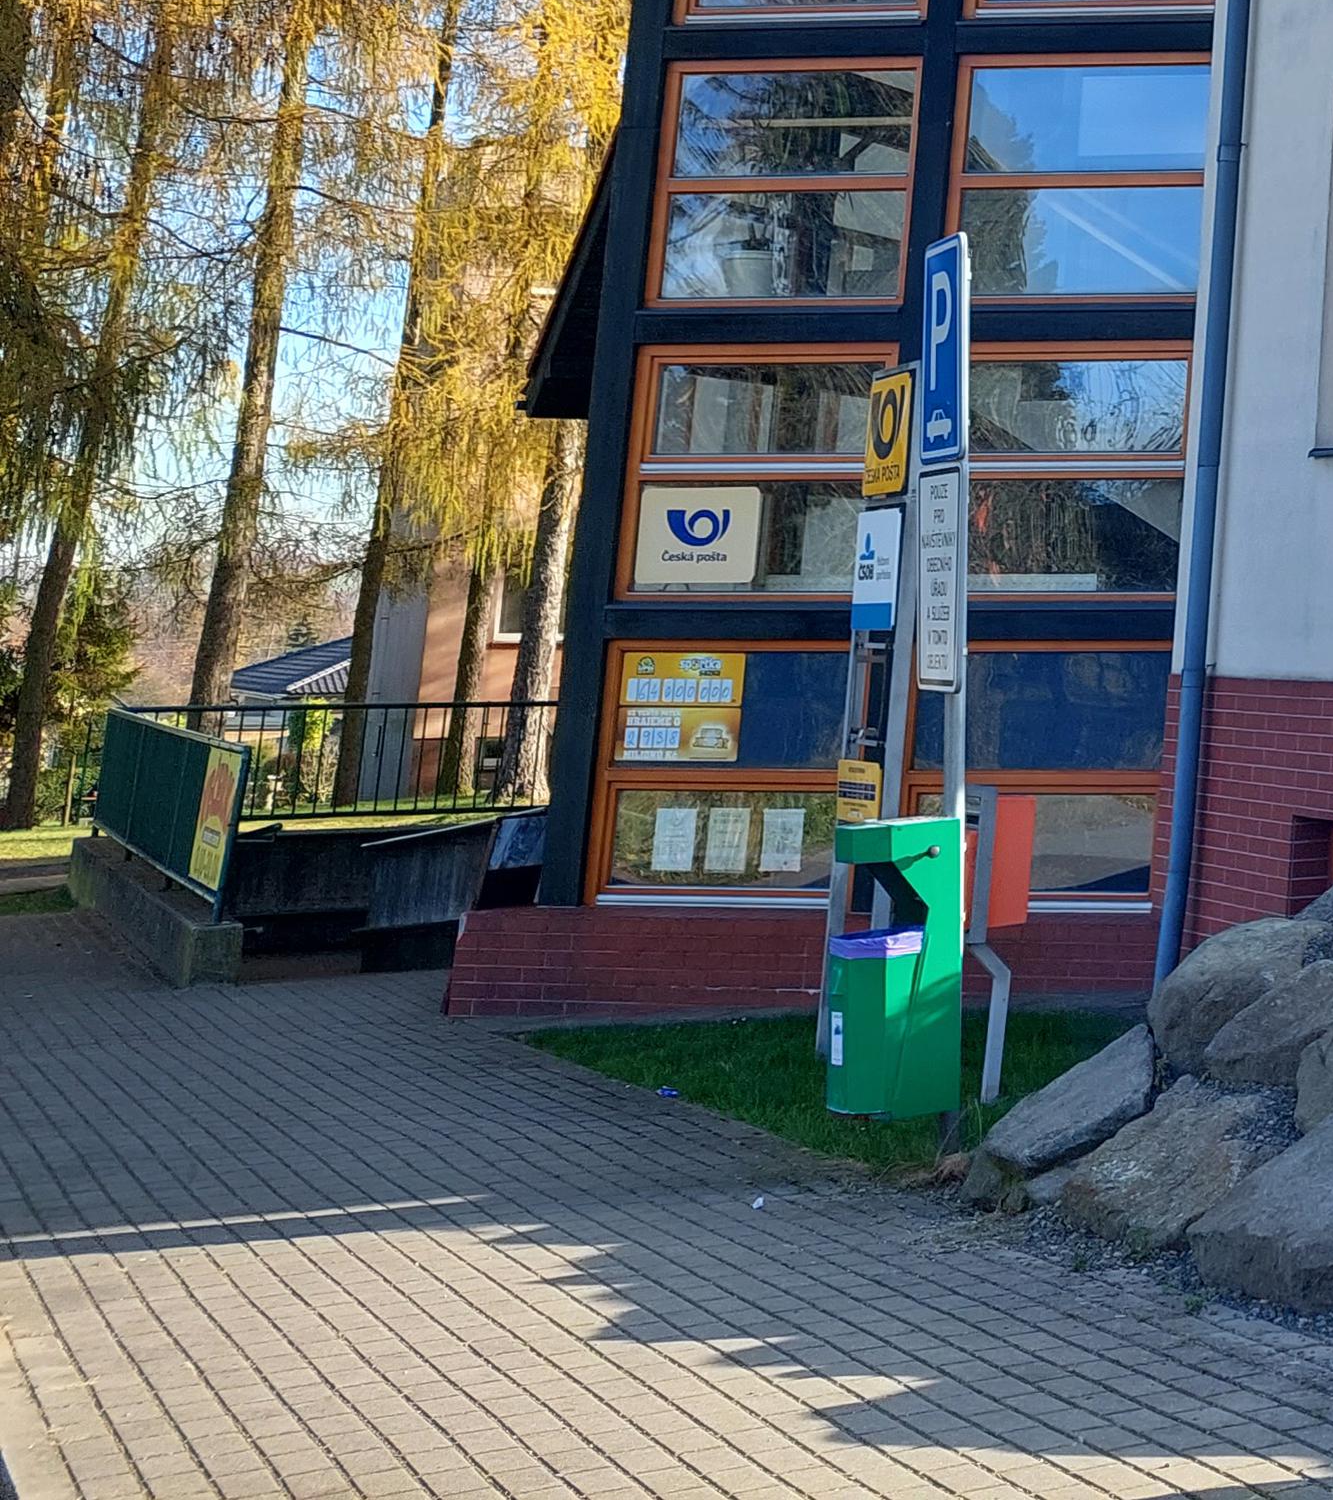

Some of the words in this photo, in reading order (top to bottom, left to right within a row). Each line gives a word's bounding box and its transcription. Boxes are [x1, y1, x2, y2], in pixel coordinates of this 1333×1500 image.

[930, 270, 952, 391] P
[865, 465, 881, 485] ČESKÁ
[881, 461, 900, 483] POŠTA
[930, 483, 948, 500] POUZE
[933, 508, 945, 524] PRO
[661, 549, 694, 563] Česká
[696, 550, 727, 564] pošta
[858, 562, 874, 580] ČSOB
